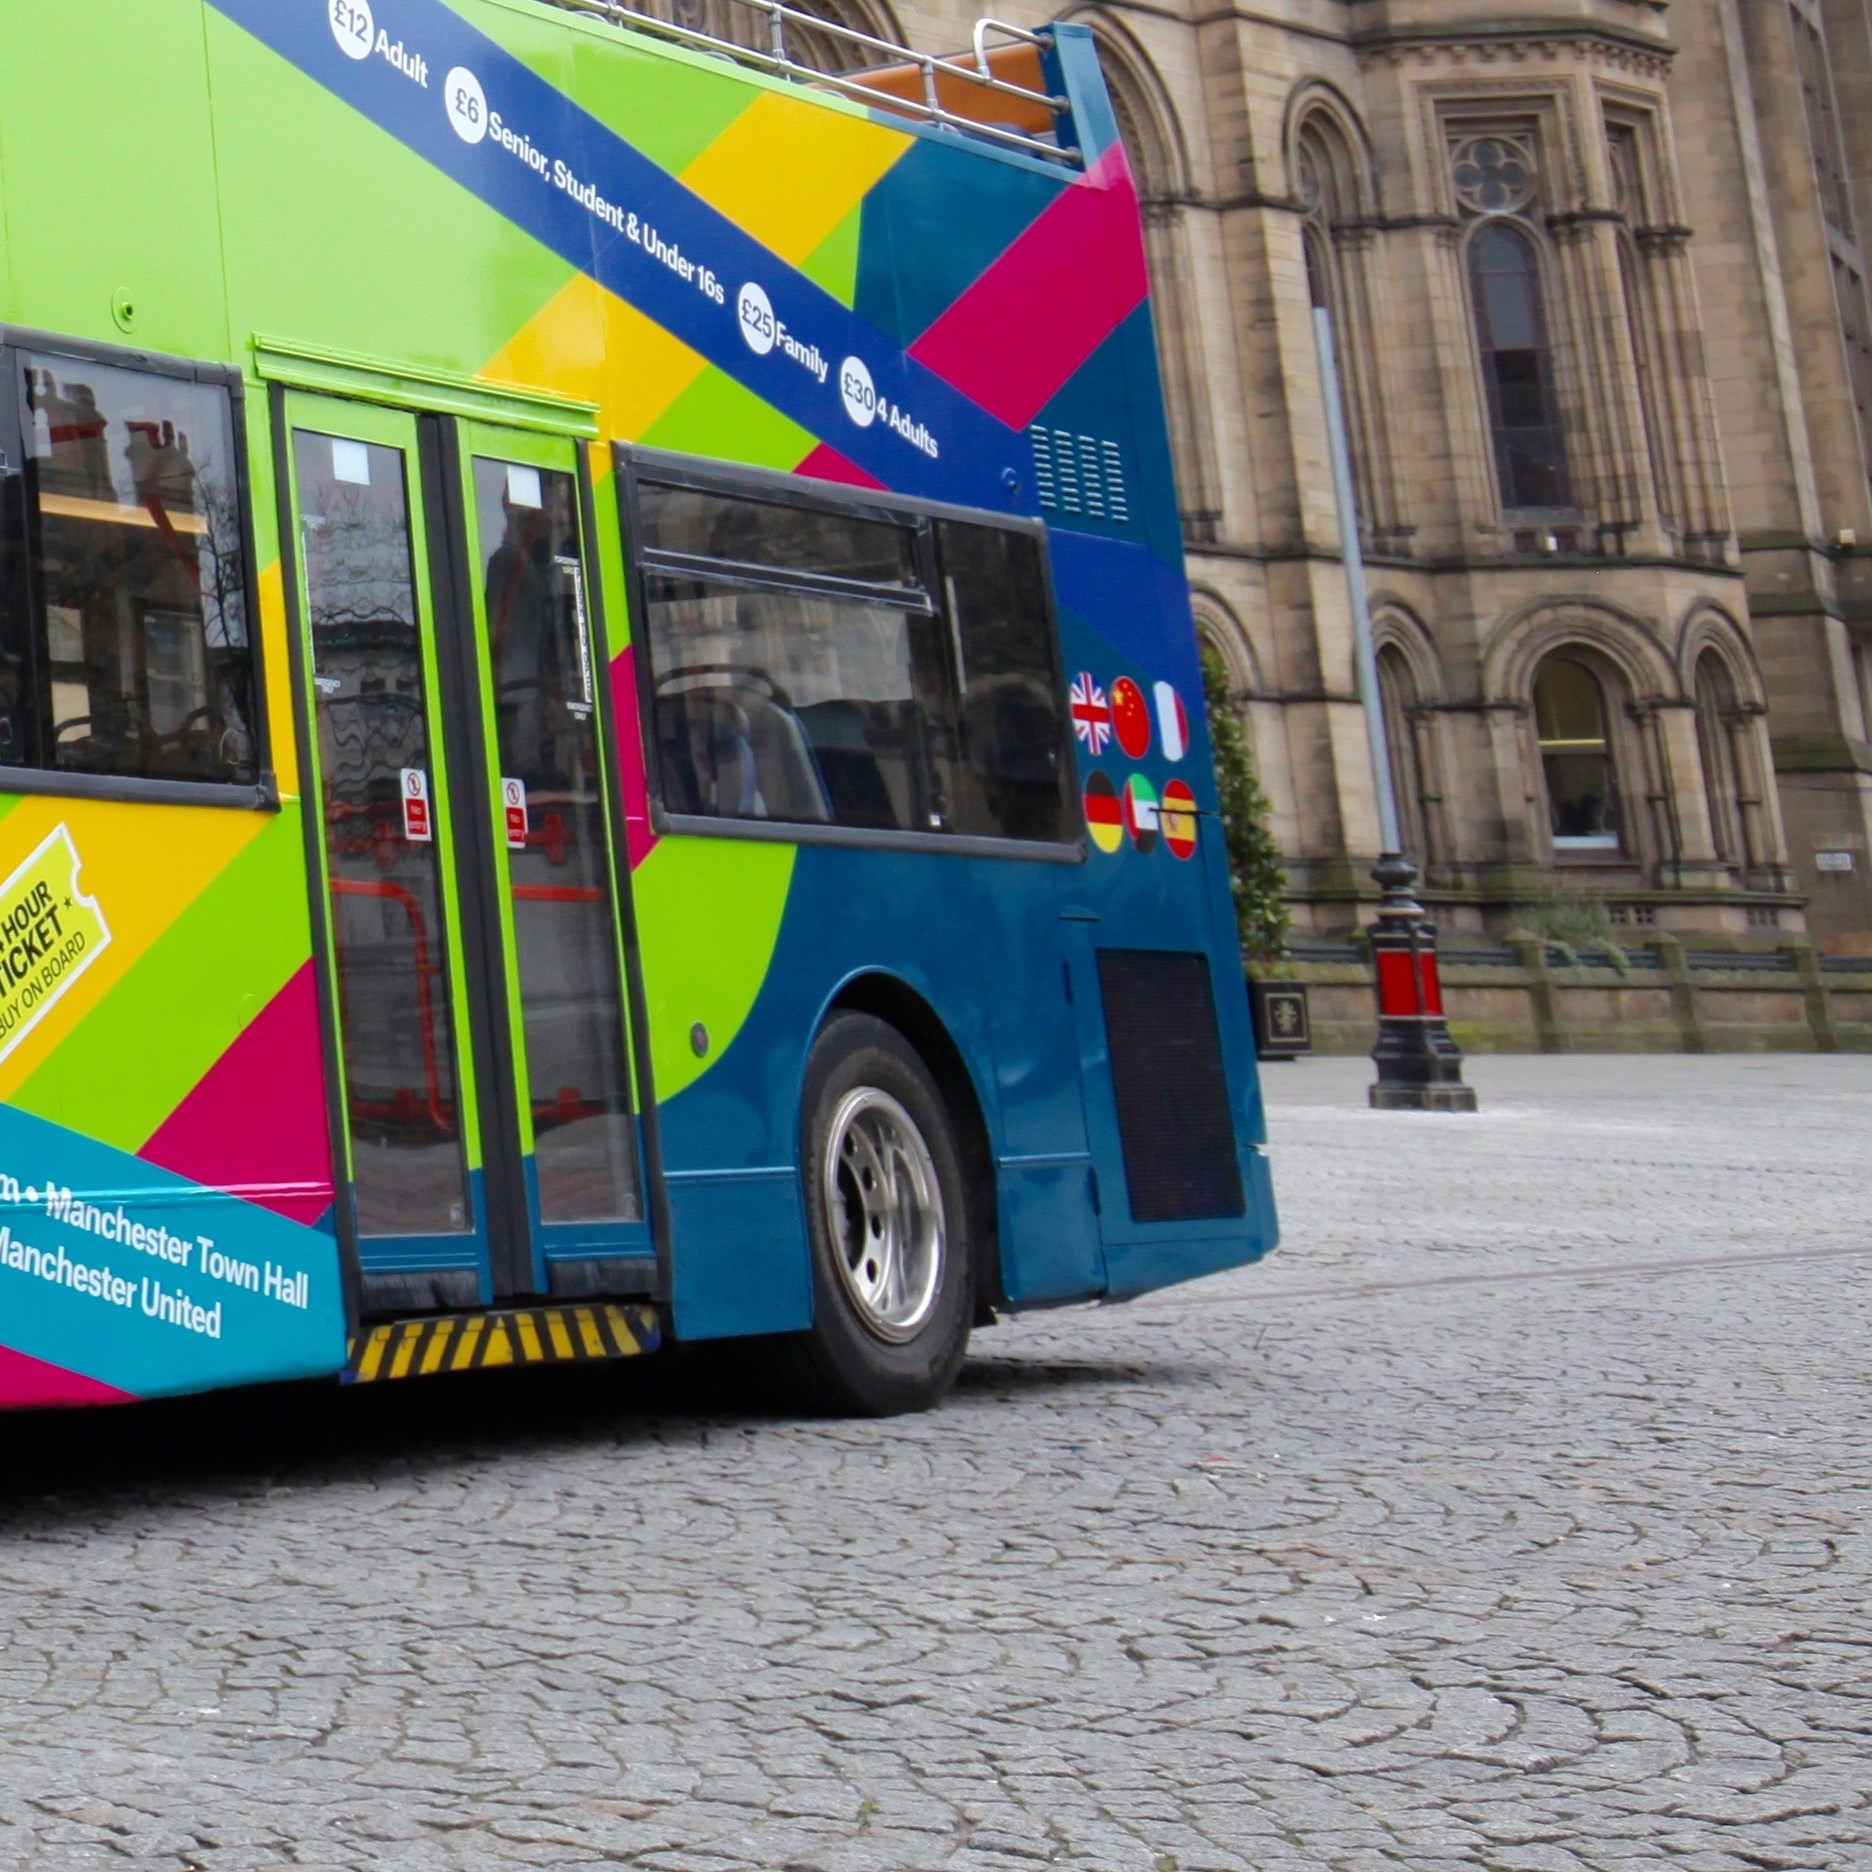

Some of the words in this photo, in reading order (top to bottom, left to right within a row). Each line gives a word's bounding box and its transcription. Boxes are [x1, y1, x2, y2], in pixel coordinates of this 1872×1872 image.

[374, 28, 429, 88] Adult
[455, 87, 480, 125] £6
[488, 111, 550, 181] Senior,
[554, 159, 624, 232] Student
[626, 212, 641, 244] &
[643, 223, 695, 282] Under
[697, 265, 725, 304] 16s
[741, 298, 772, 338] £25
[775, 320, 829, 383] Family
[843, 372, 874, 412] £30
[876, 397, 887, 422] 4
[889, 405, 939, 458] Adults
[1, 880, 53, 946] HOUR
[20, 982, 44, 1009] ON
[41, 930, 86, 986] BOARD
[46, 1181, 193, 1267] Manchester
[196, 1236, 260, 1292] Town
[263, 1260, 309, 1310] Hall
[140, 1276, 222, 1339] United
